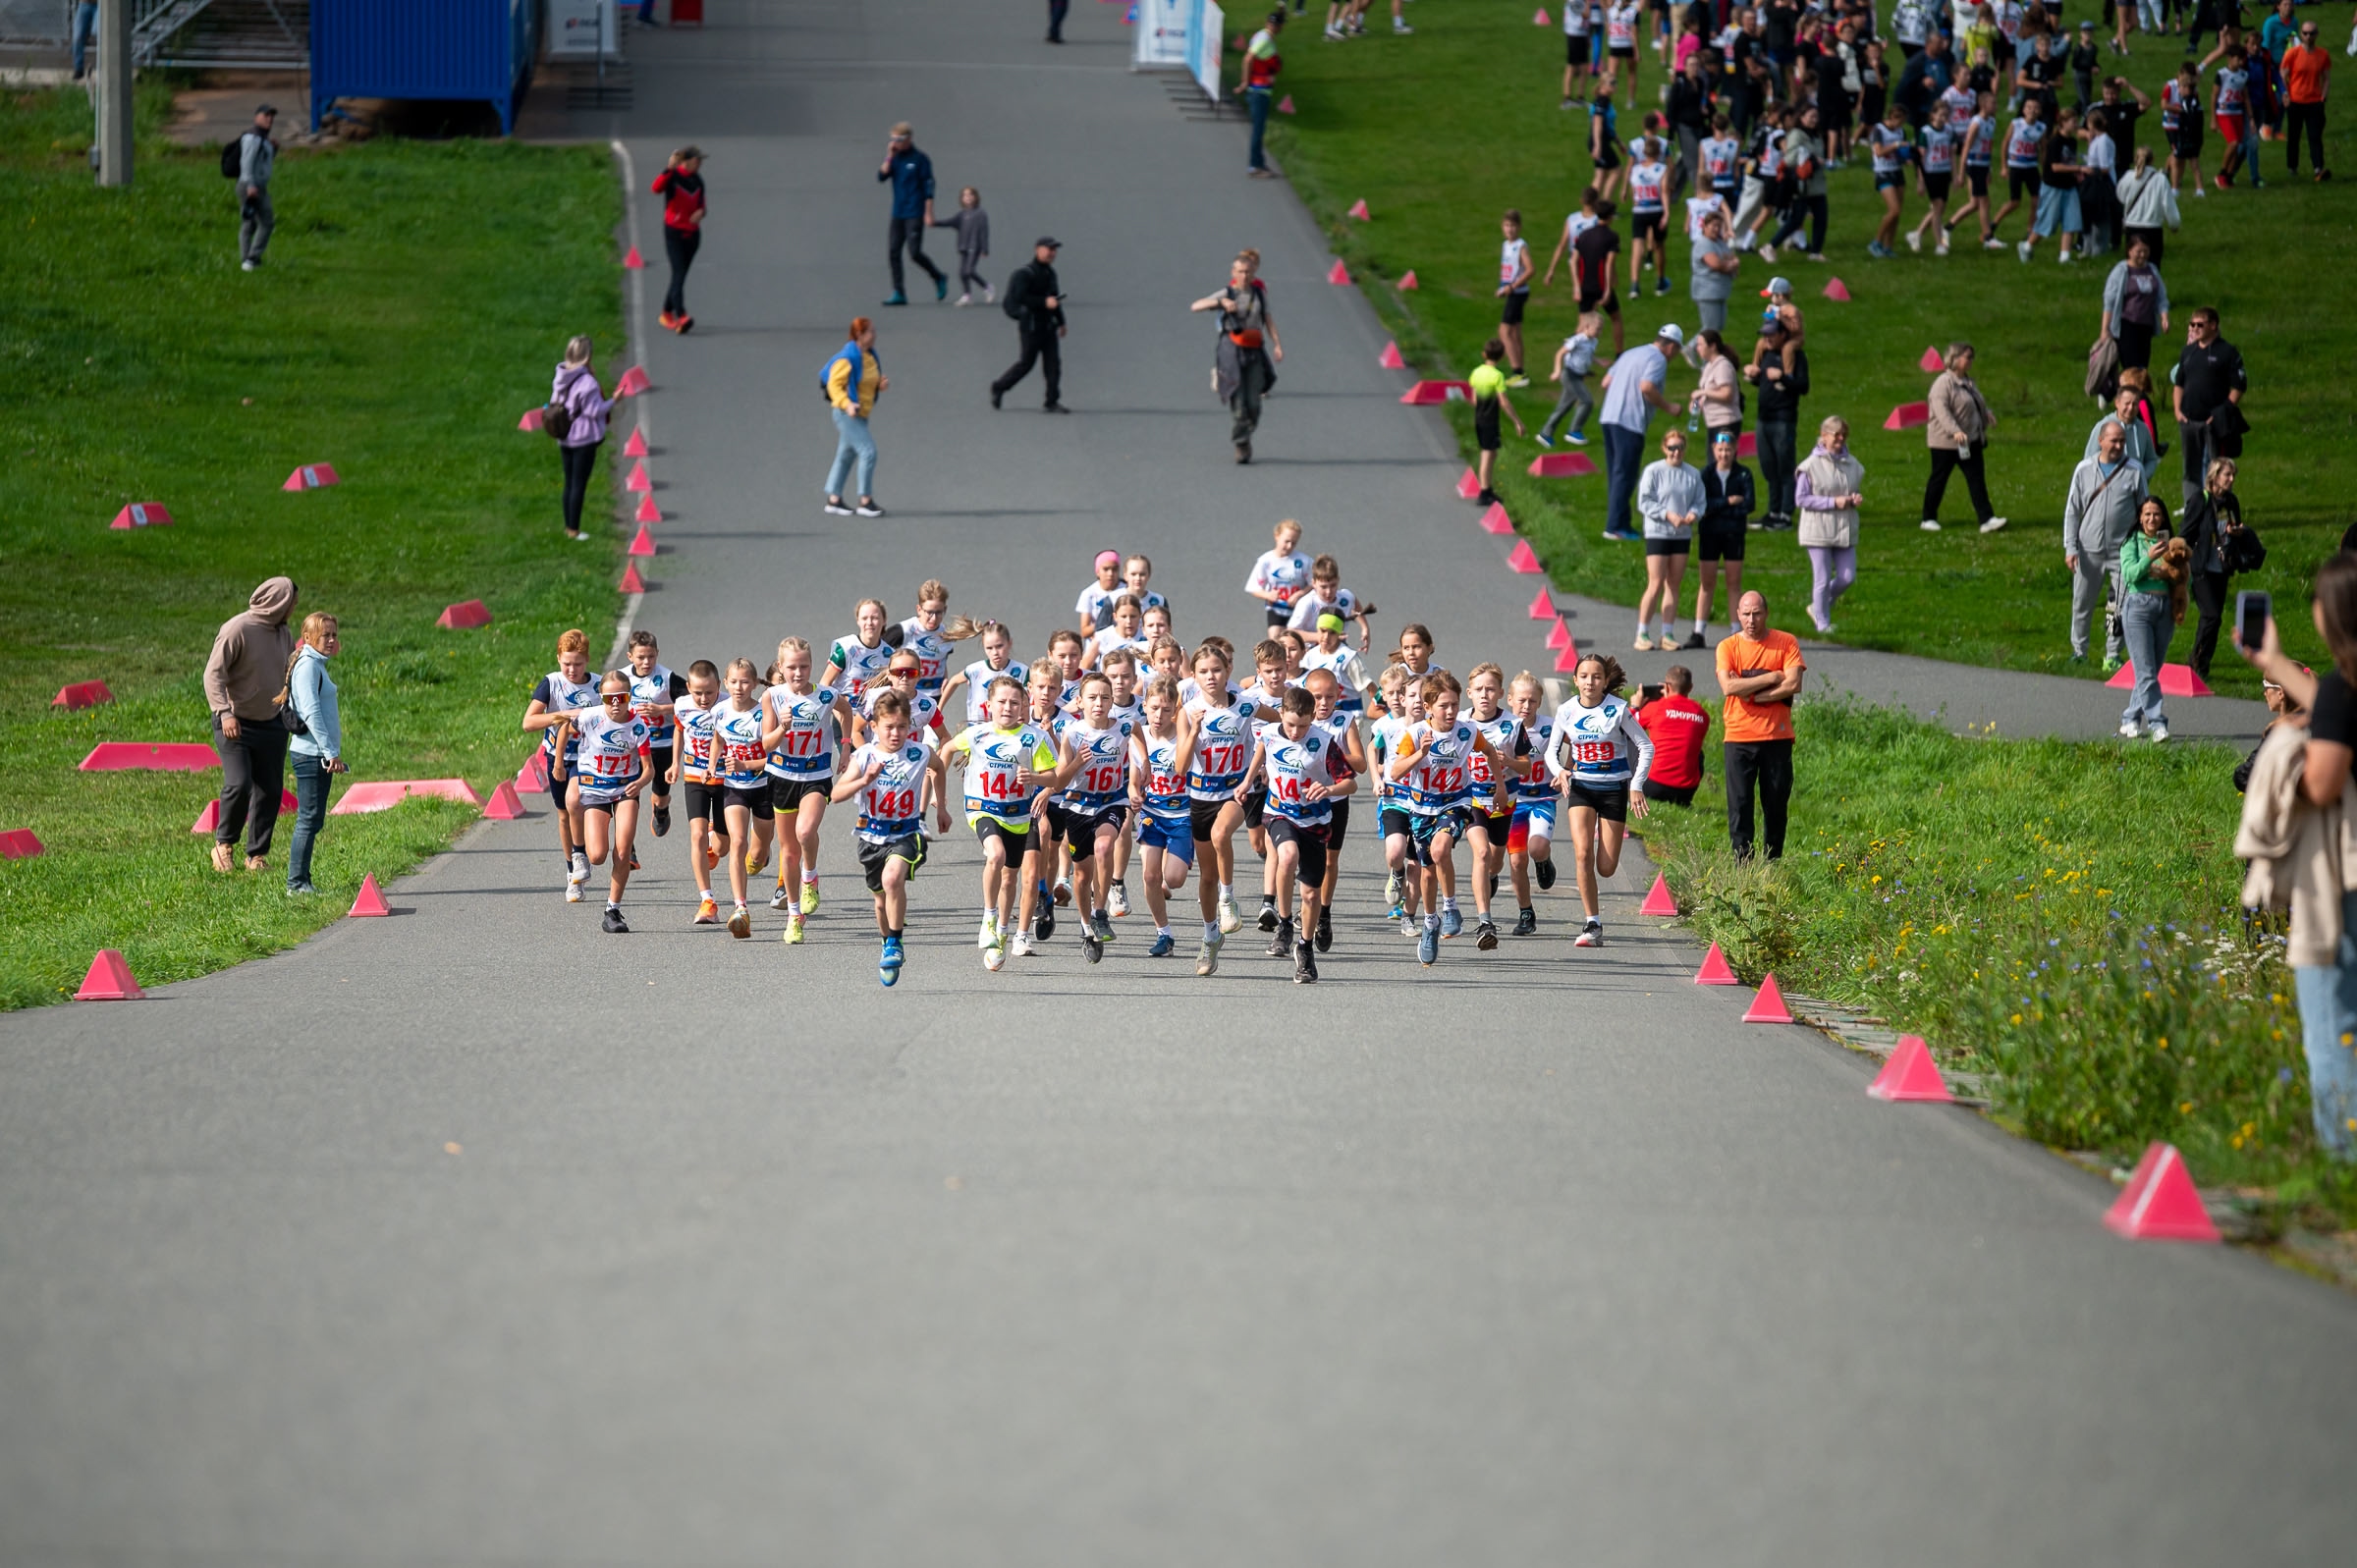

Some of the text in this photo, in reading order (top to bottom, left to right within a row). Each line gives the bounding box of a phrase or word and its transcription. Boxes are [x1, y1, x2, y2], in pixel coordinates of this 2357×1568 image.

[1666, 709, 1705, 724] УДМУРТИЯ
[786, 729, 823, 756] 171
[1574, 740, 1615, 762] 189
[594, 754, 631, 775] 177
[1200, 743, 1244, 775] 170
[1278, 766, 1300, 775] СТРИЖ
[979, 771, 1025, 799] 144
[1085, 763, 1123, 792] 161
[1419, 767, 1463, 793] 142
[866, 788, 914, 819] 149
